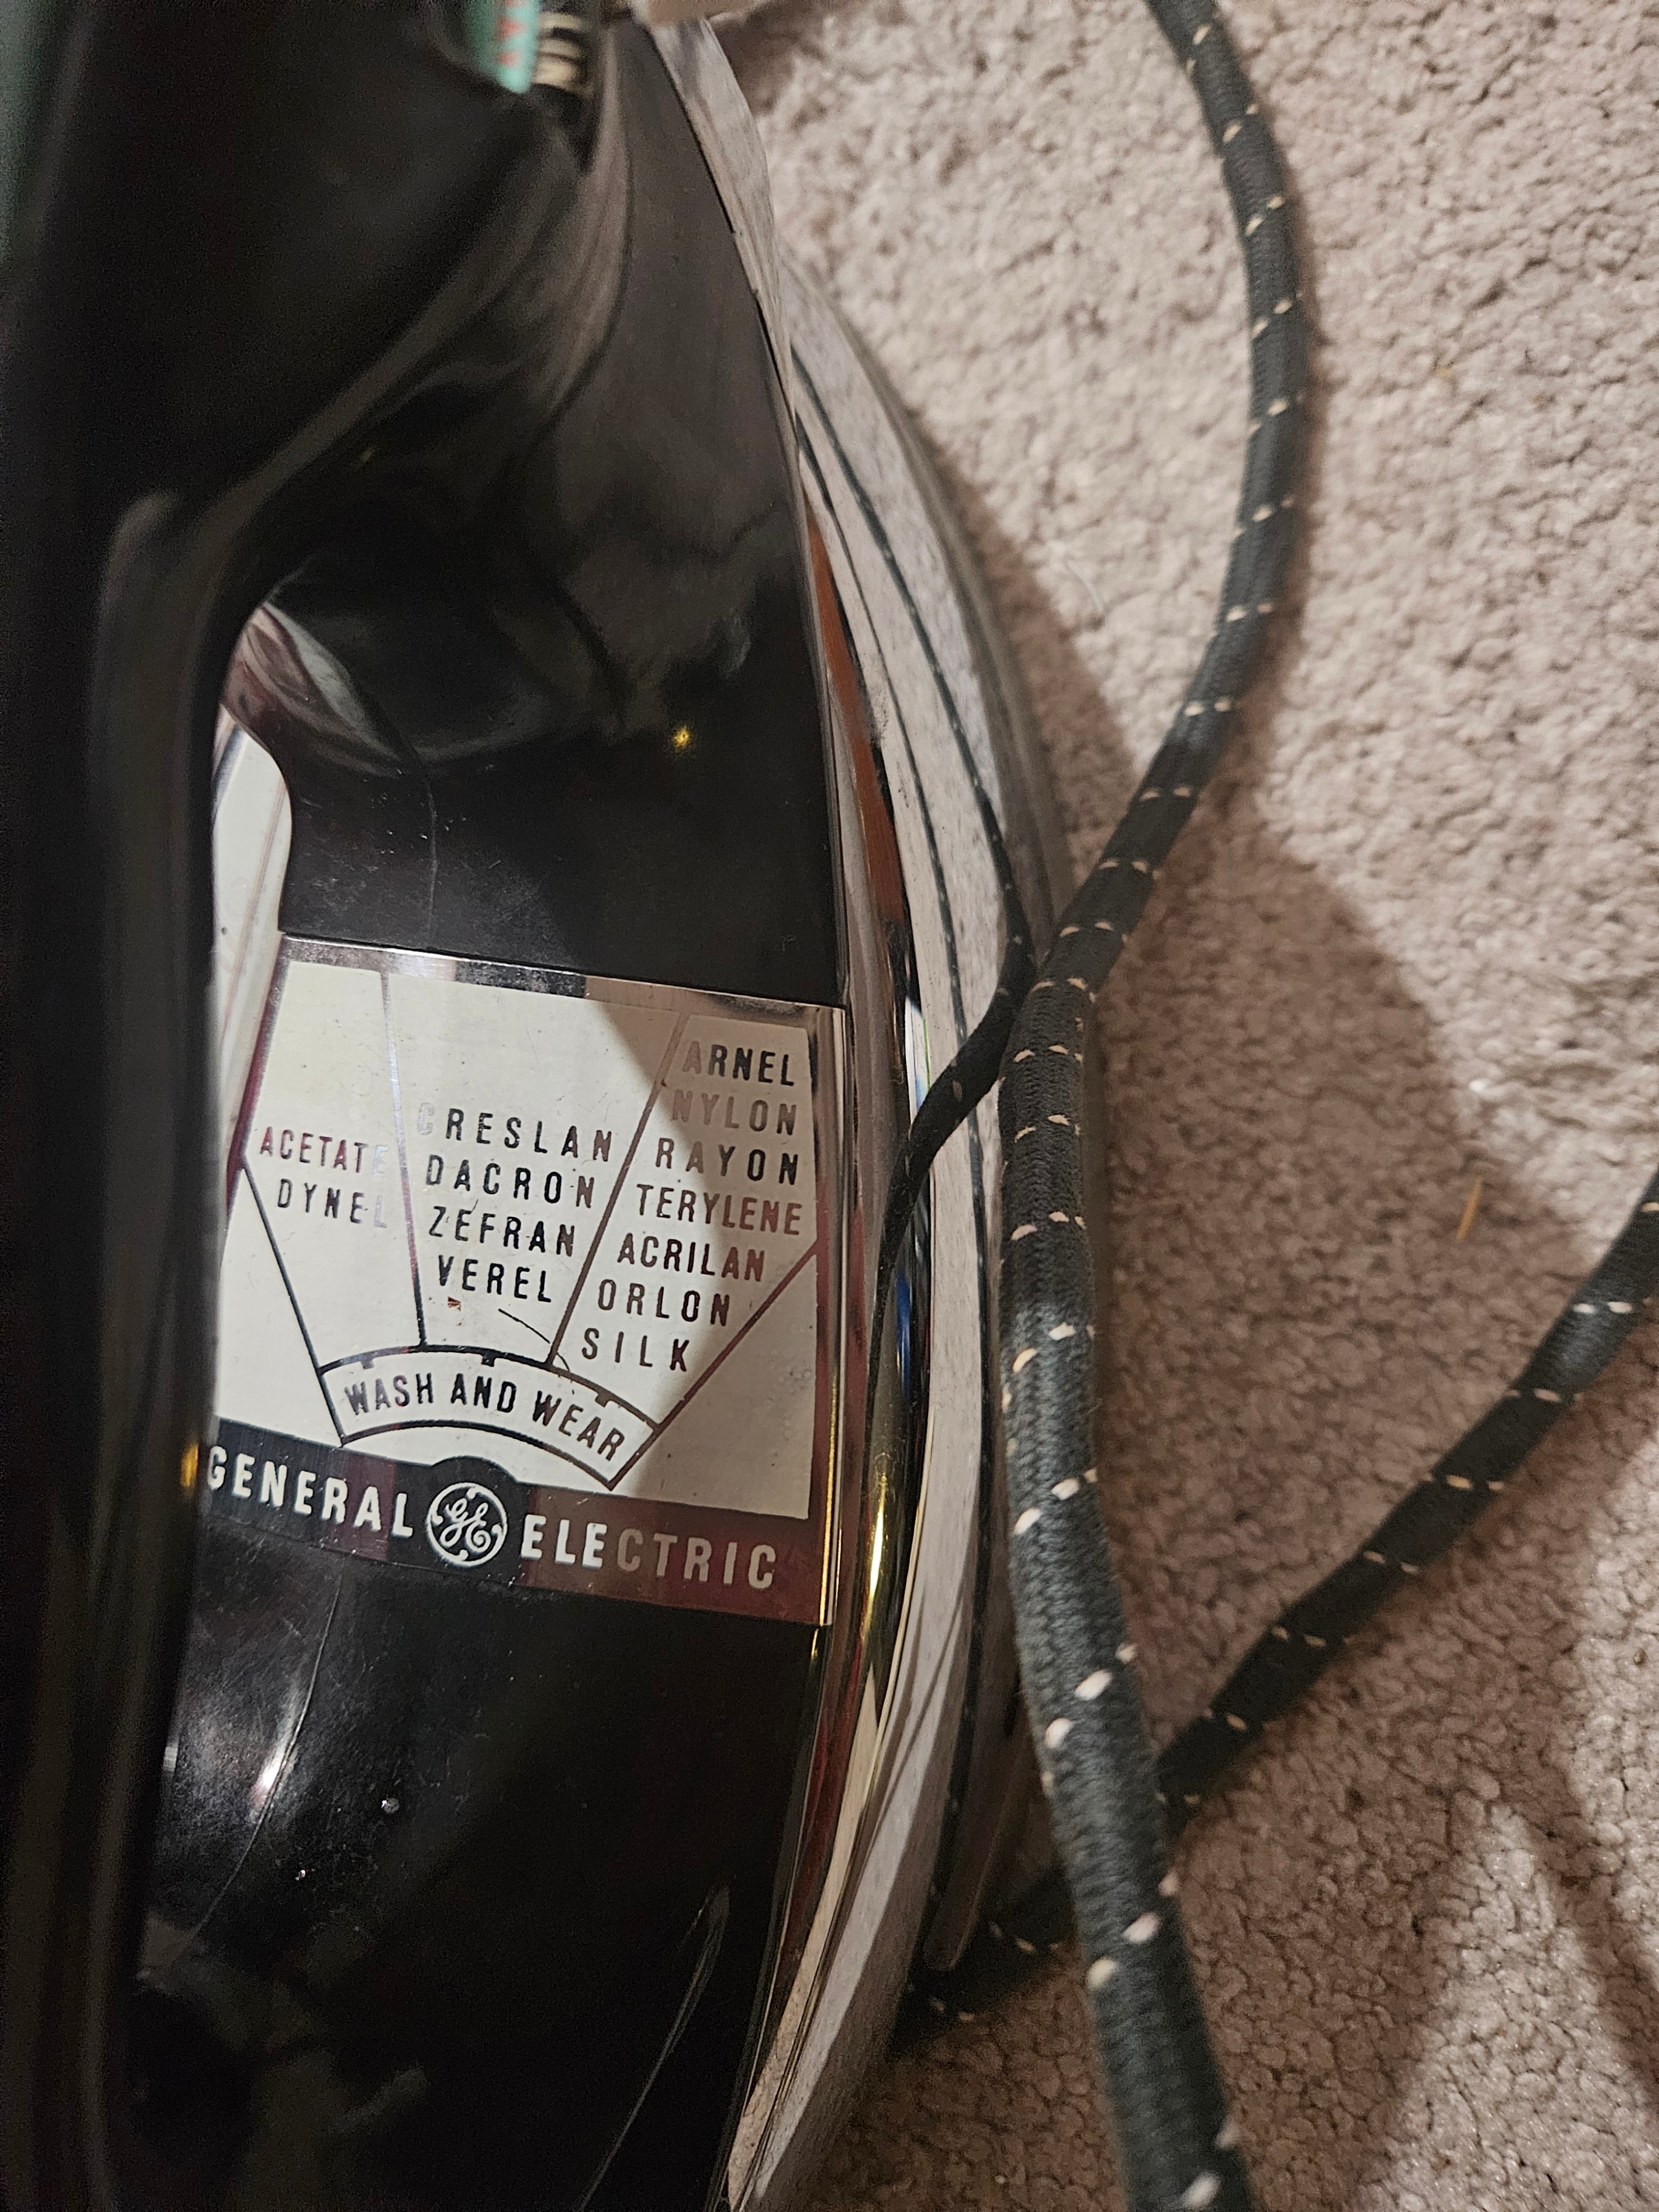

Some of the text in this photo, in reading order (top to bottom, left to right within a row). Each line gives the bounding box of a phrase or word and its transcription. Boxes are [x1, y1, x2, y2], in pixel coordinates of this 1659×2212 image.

[683, 1041, 794, 1086] ARNEL
[417, 1103, 612, 1162] CRESLAN
[672, 1090, 796, 1135] NYLON
[260, 1126, 388, 1177] ACETATE
[656, 1137, 798, 1185] RAYON
[278, 1178, 387, 1228] DYNEL
[426, 1154, 594, 1208] DACRON
[429, 1206, 575, 1257] ZEFRAN
[637, 1184, 802, 1235] TERYLENE
[438, 1254, 551, 1303] VEREL
[618, 1233, 765, 1282] ACRILAN
[598, 1279, 729, 1327] ORLON
[582, 1328, 689, 1372] SILK
[345, 1373, 625, 1462] WASH AND WEAR
[207, 1445, 413, 1539] GENERAL
[521, 1514, 777, 1589] ELECTRIC
